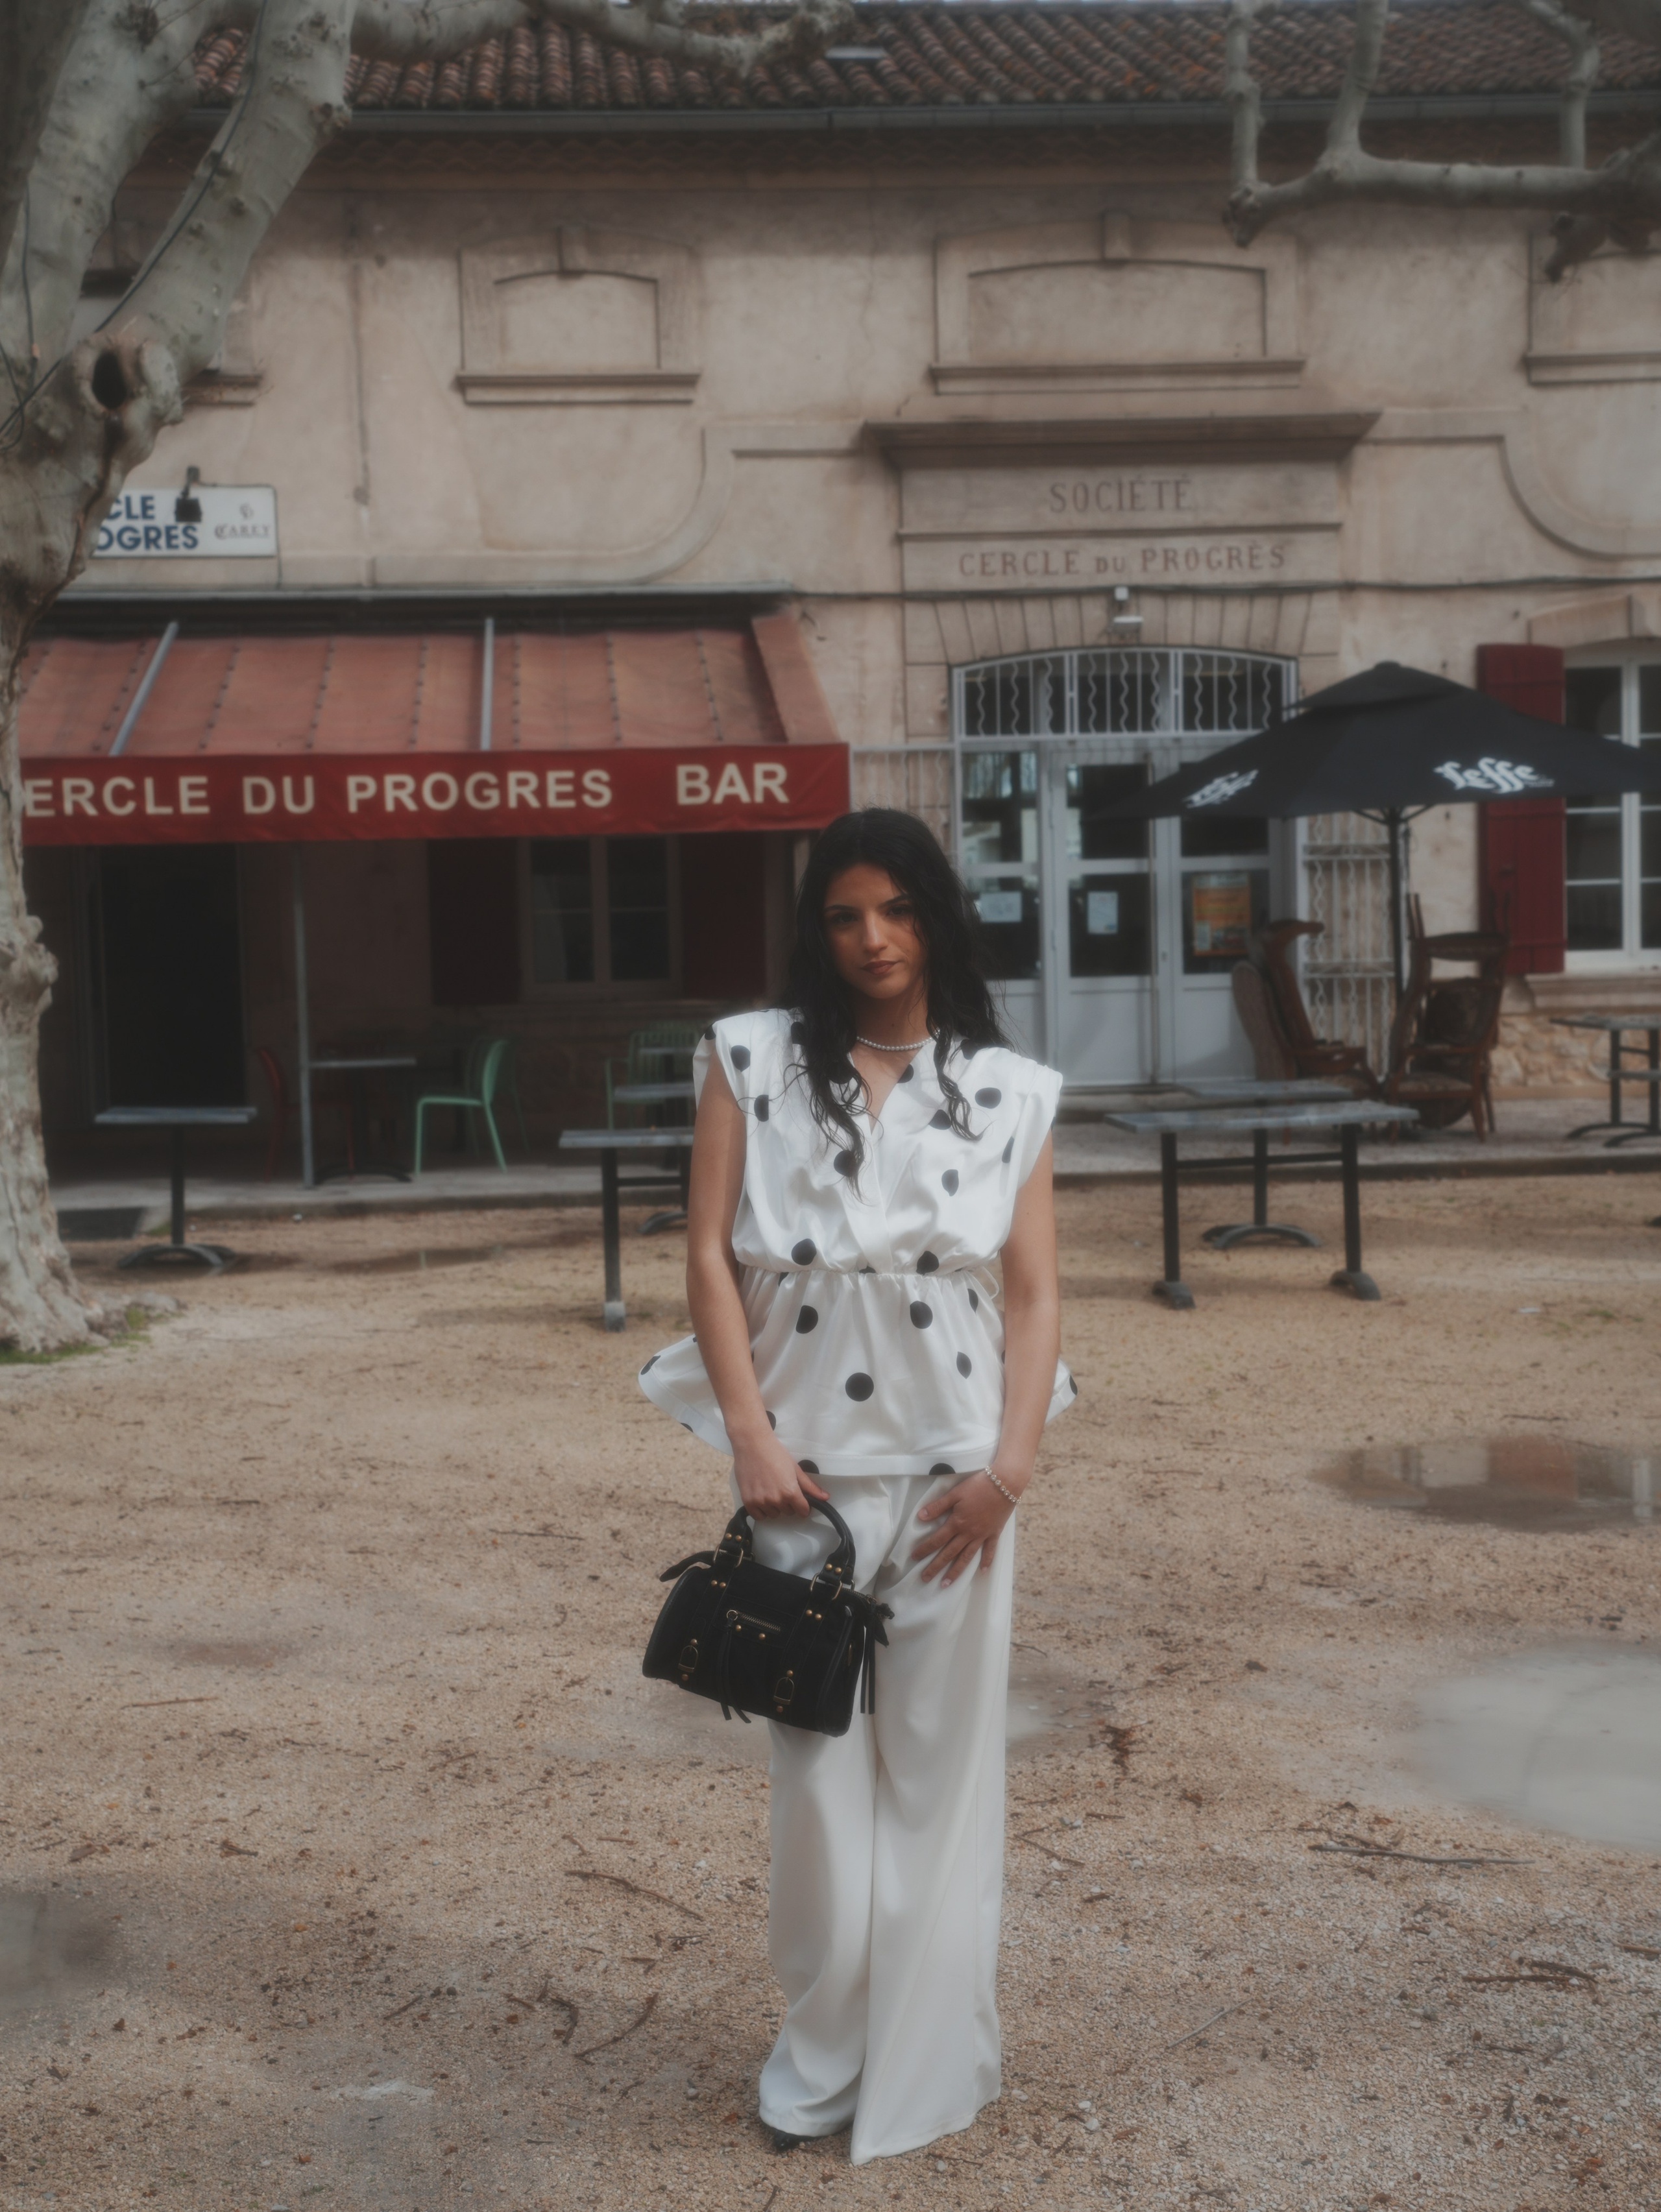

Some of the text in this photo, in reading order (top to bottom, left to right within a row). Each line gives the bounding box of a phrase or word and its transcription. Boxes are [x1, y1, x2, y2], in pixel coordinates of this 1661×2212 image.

[97, 525, 198, 550] OGRES
[958, 549, 1081, 577] CERCLE
[1141, 544, 1285, 573] PROGRÈS
[24, 762, 790, 817] ERCLE DU PROGRES BAR
